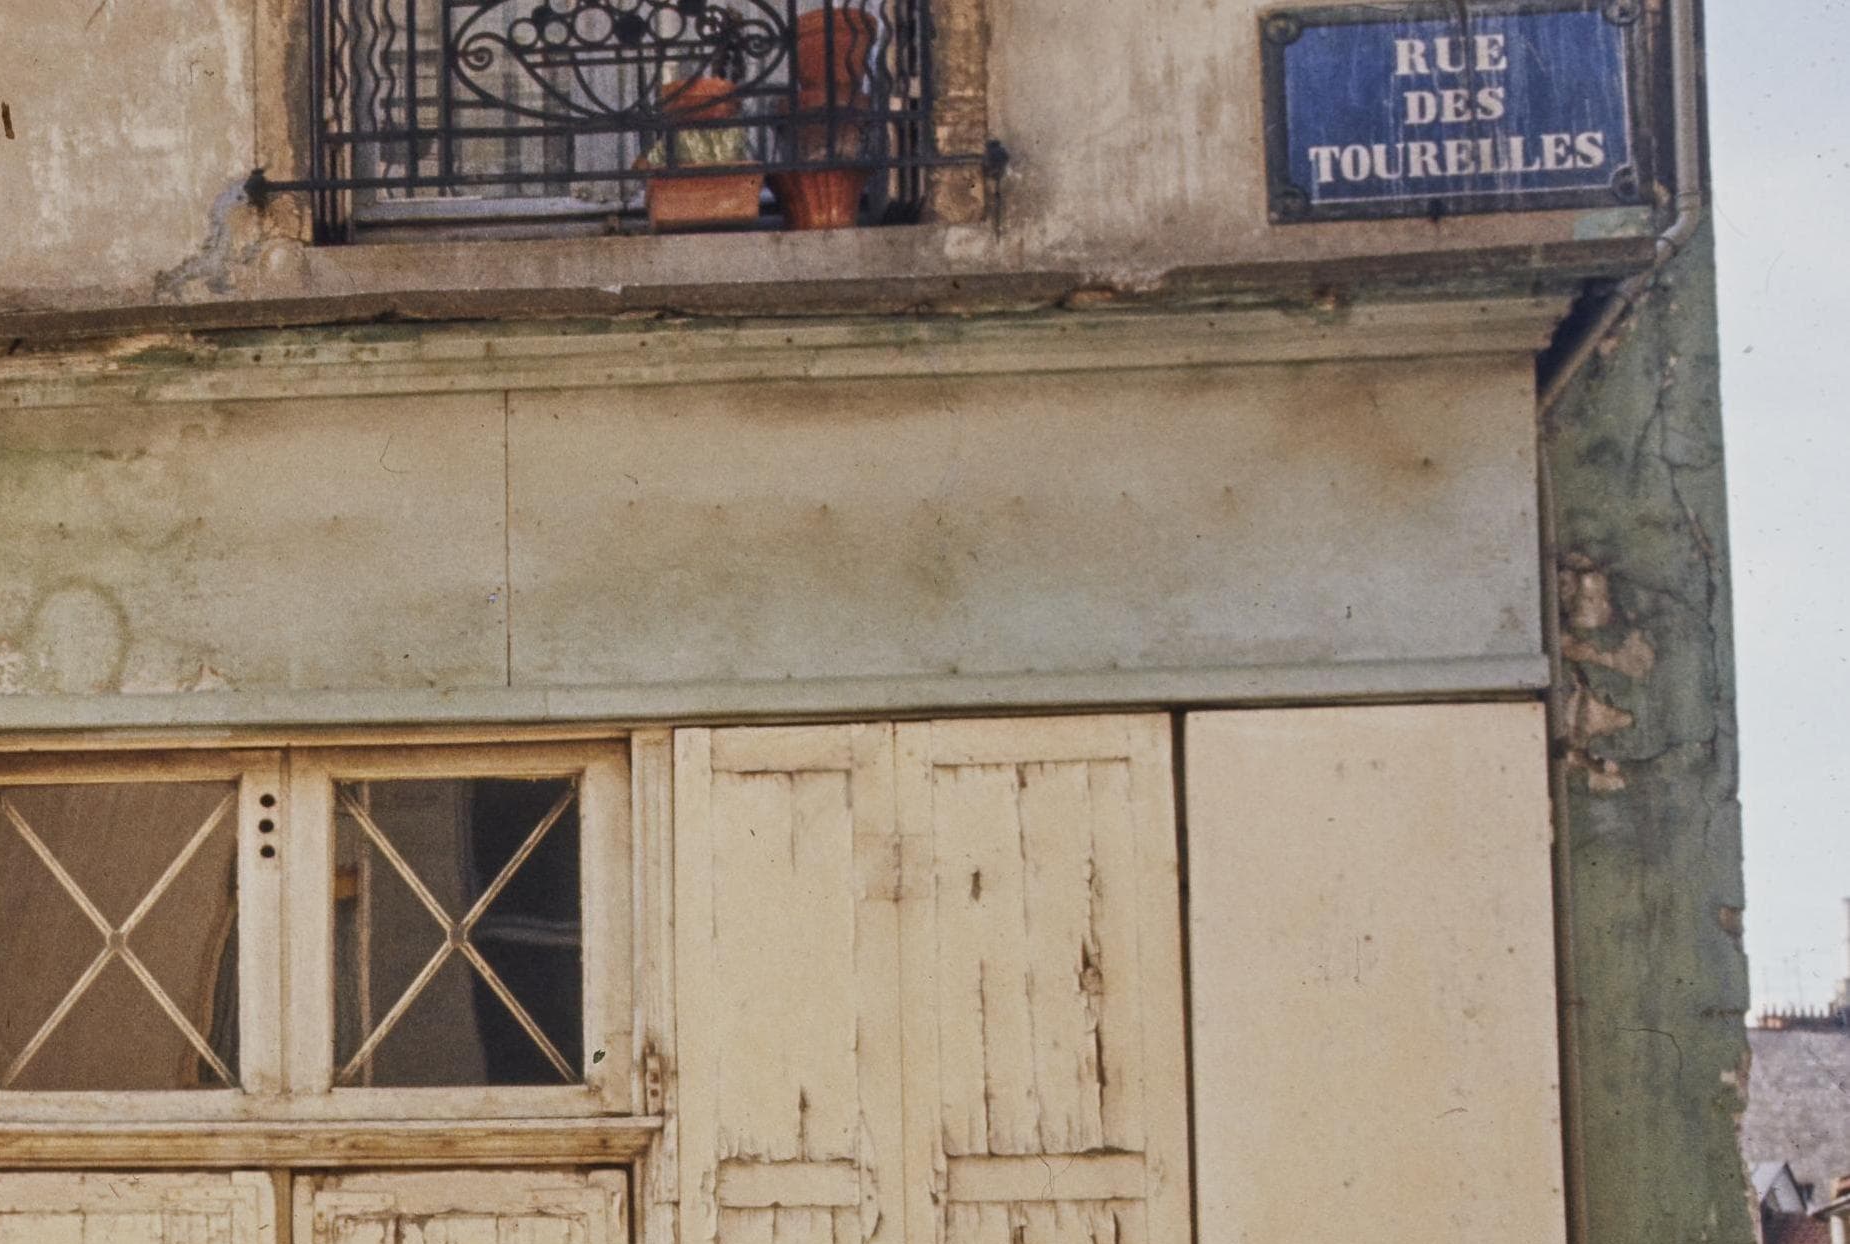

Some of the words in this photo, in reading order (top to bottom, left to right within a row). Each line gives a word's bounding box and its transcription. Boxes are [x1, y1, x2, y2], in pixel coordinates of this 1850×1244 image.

[1395, 34, 1507, 76] RUE
[1404, 87, 1504, 125] DES
[1308, 132, 1605, 183] TOURELLES
